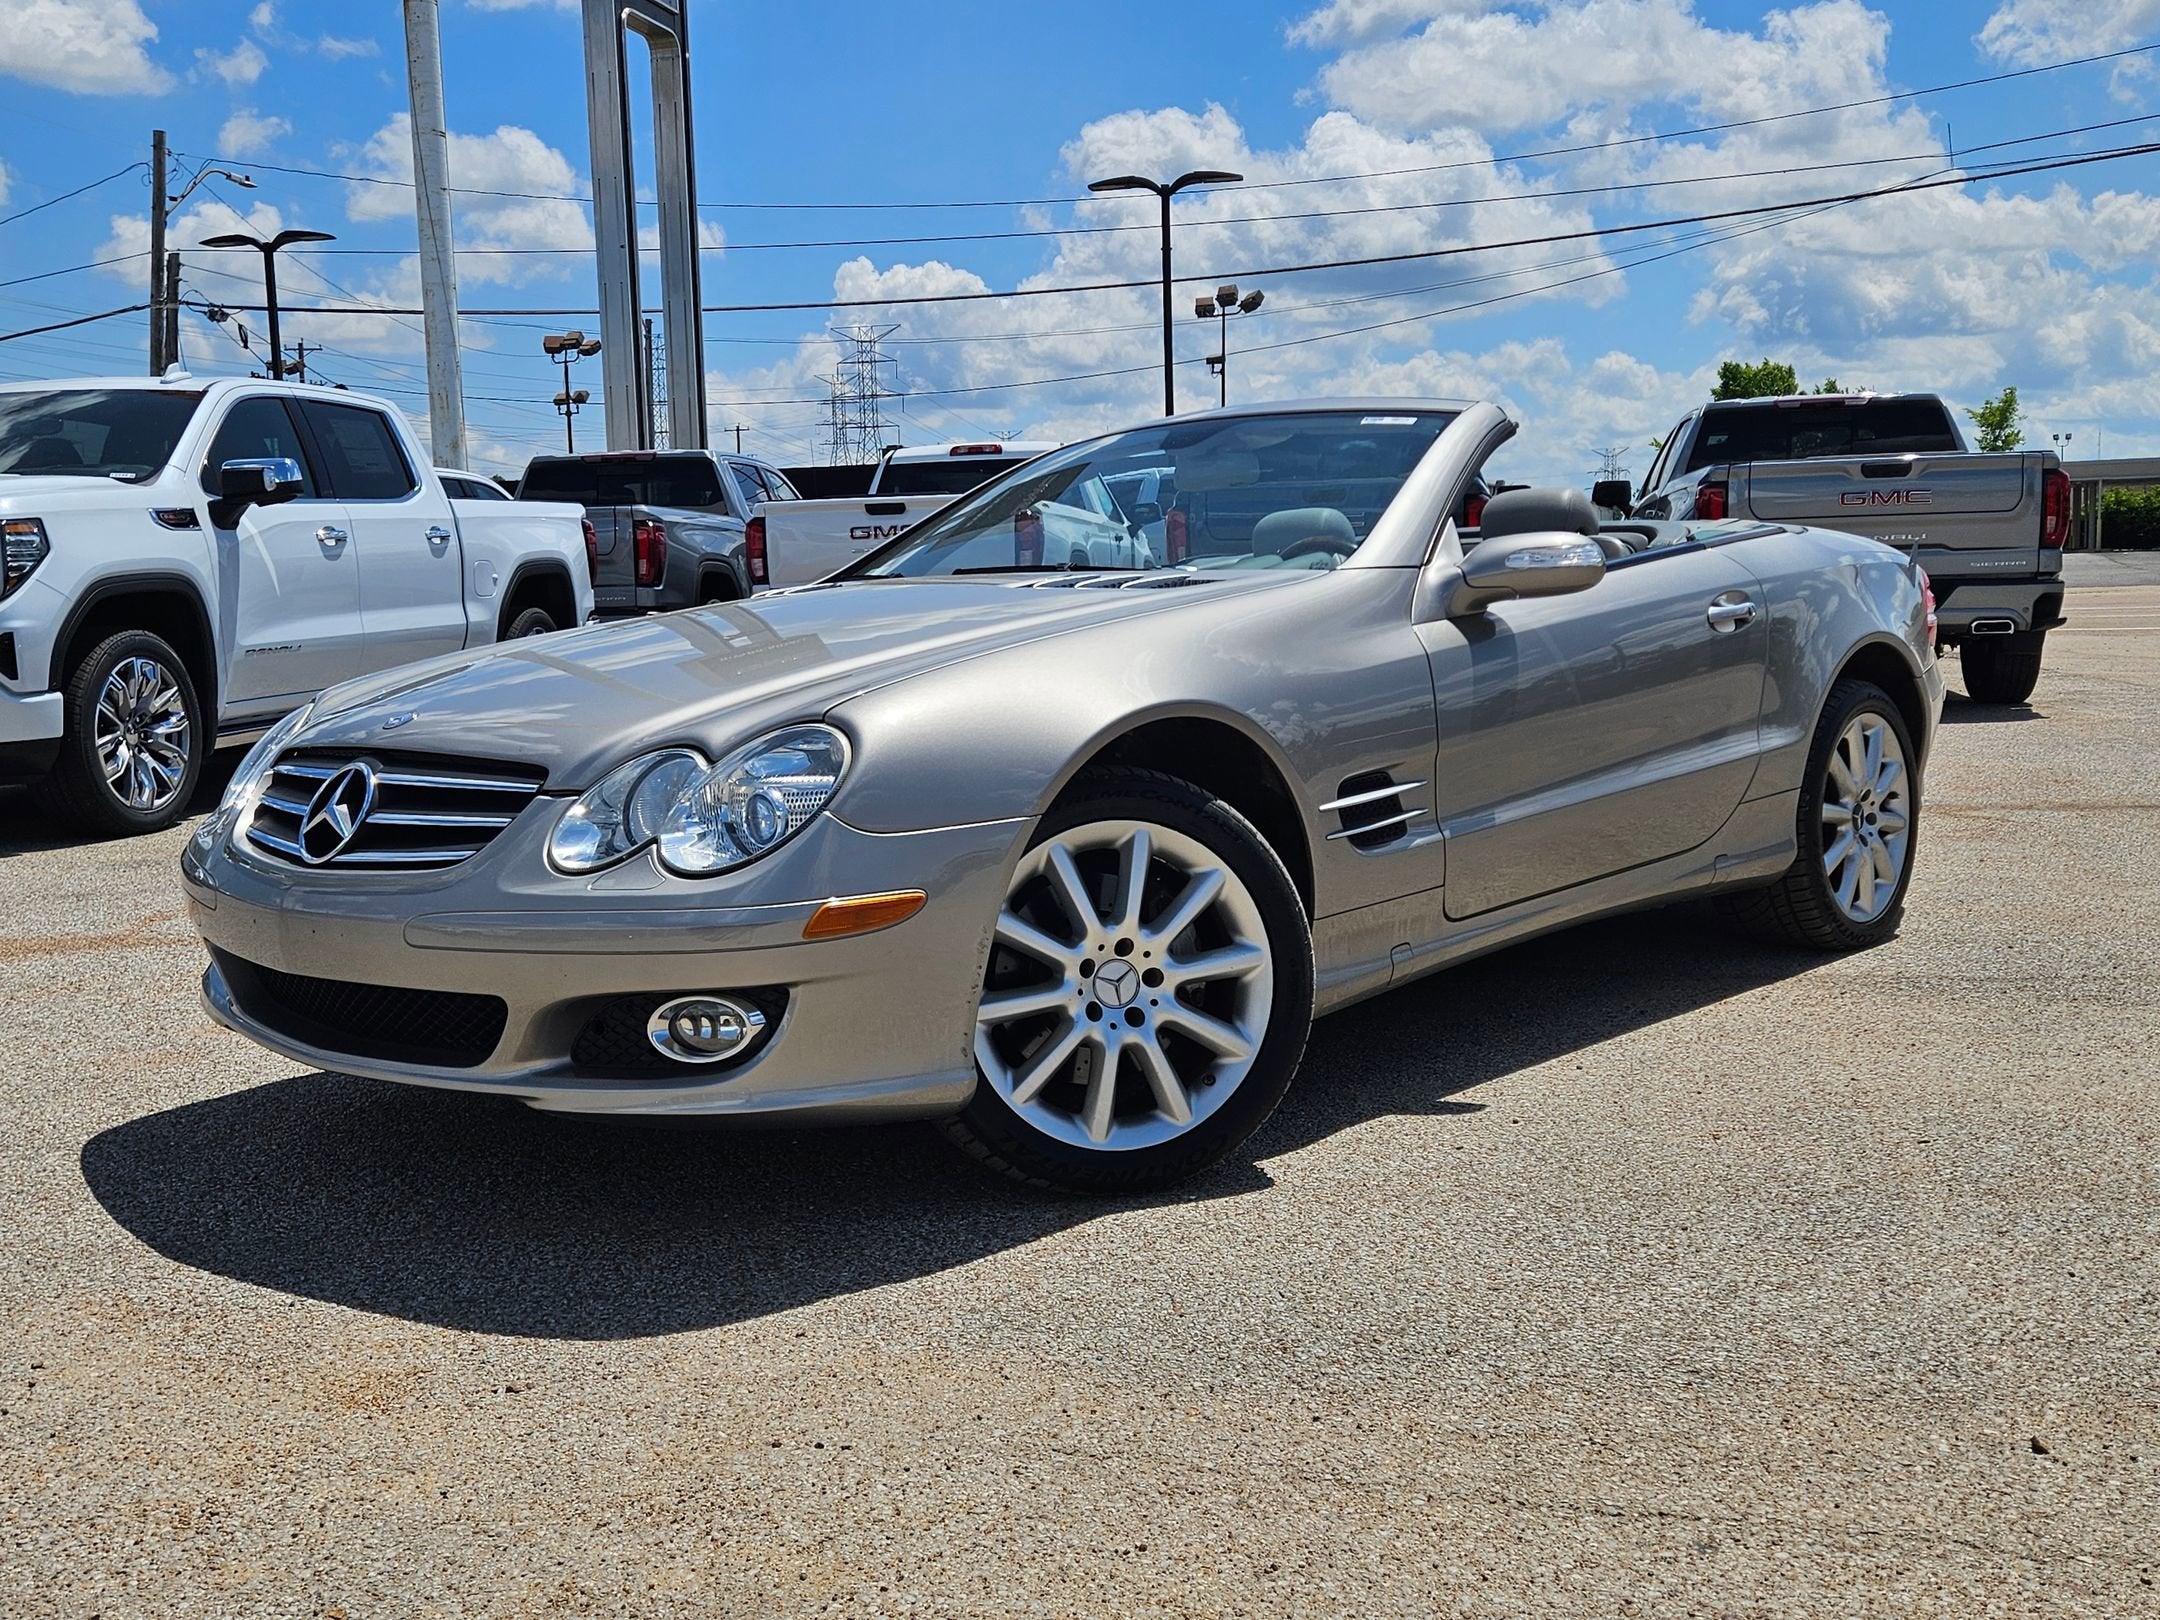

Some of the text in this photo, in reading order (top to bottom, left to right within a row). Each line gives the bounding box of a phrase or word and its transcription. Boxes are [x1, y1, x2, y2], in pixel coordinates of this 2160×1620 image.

[1839, 488, 1932, 506] GMC
[1873, 533, 1927, 542] NALI
[1970, 560, 2026, 568] SIERRA
[245, 646, 302, 656] DENALI
